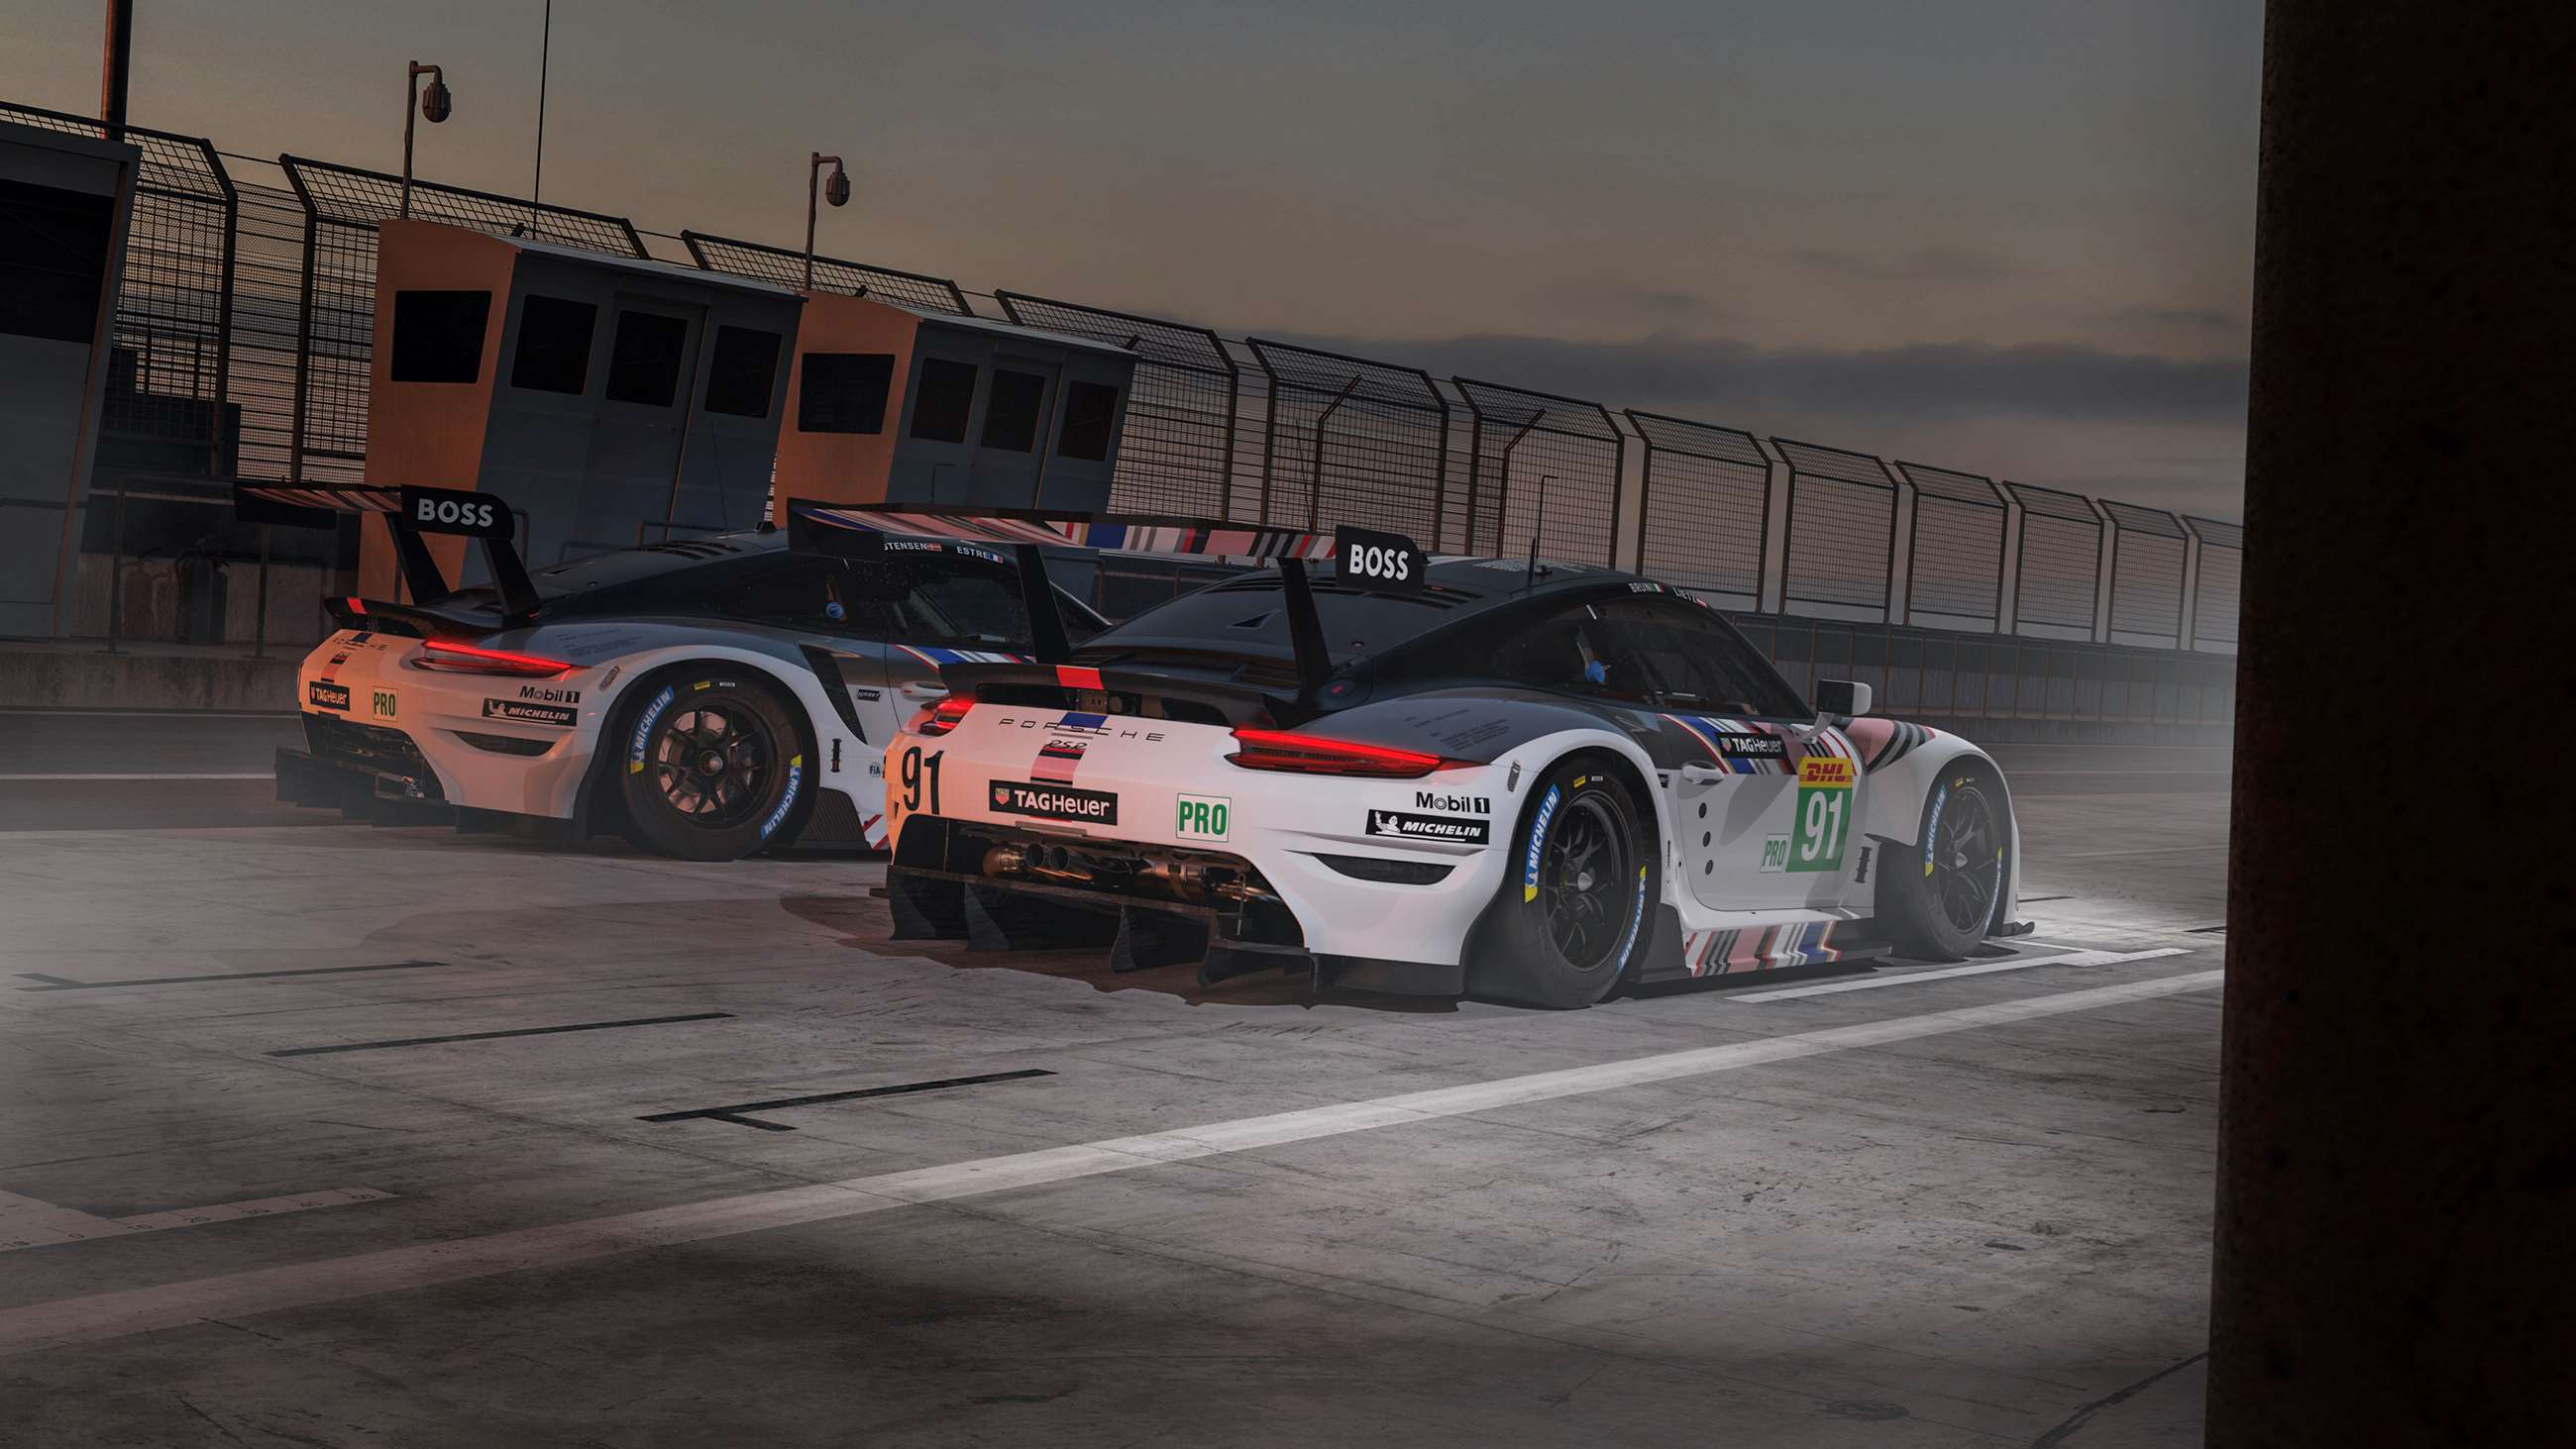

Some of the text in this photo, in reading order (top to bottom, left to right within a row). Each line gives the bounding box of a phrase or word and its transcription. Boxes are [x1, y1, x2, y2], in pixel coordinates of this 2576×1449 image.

[417, 497, 494, 528] BOSS
[1349, 543, 1410, 581] BOSS
[374, 691, 396, 716] PRO
[519, 685, 564, 702] Mobil
[507, 706, 571, 721] MICHELIN
[634, 689, 672, 751] MICHELIN
[998, 718, 1166, 743] PORSCHE
[902, 746, 945, 816] 91
[1806, 763, 1846, 782] DHL
[763, 777, 802, 836] MICHELIN
[1415, 791, 1471, 813] Mobil
[1178, 800, 1228, 836] PRO
[1402, 820, 1482, 838] MICHELIN
[1529, 791, 1558, 870] MICHELIN
[1801, 790, 1844, 862] 91
[1762, 839, 1787, 868] PRO
